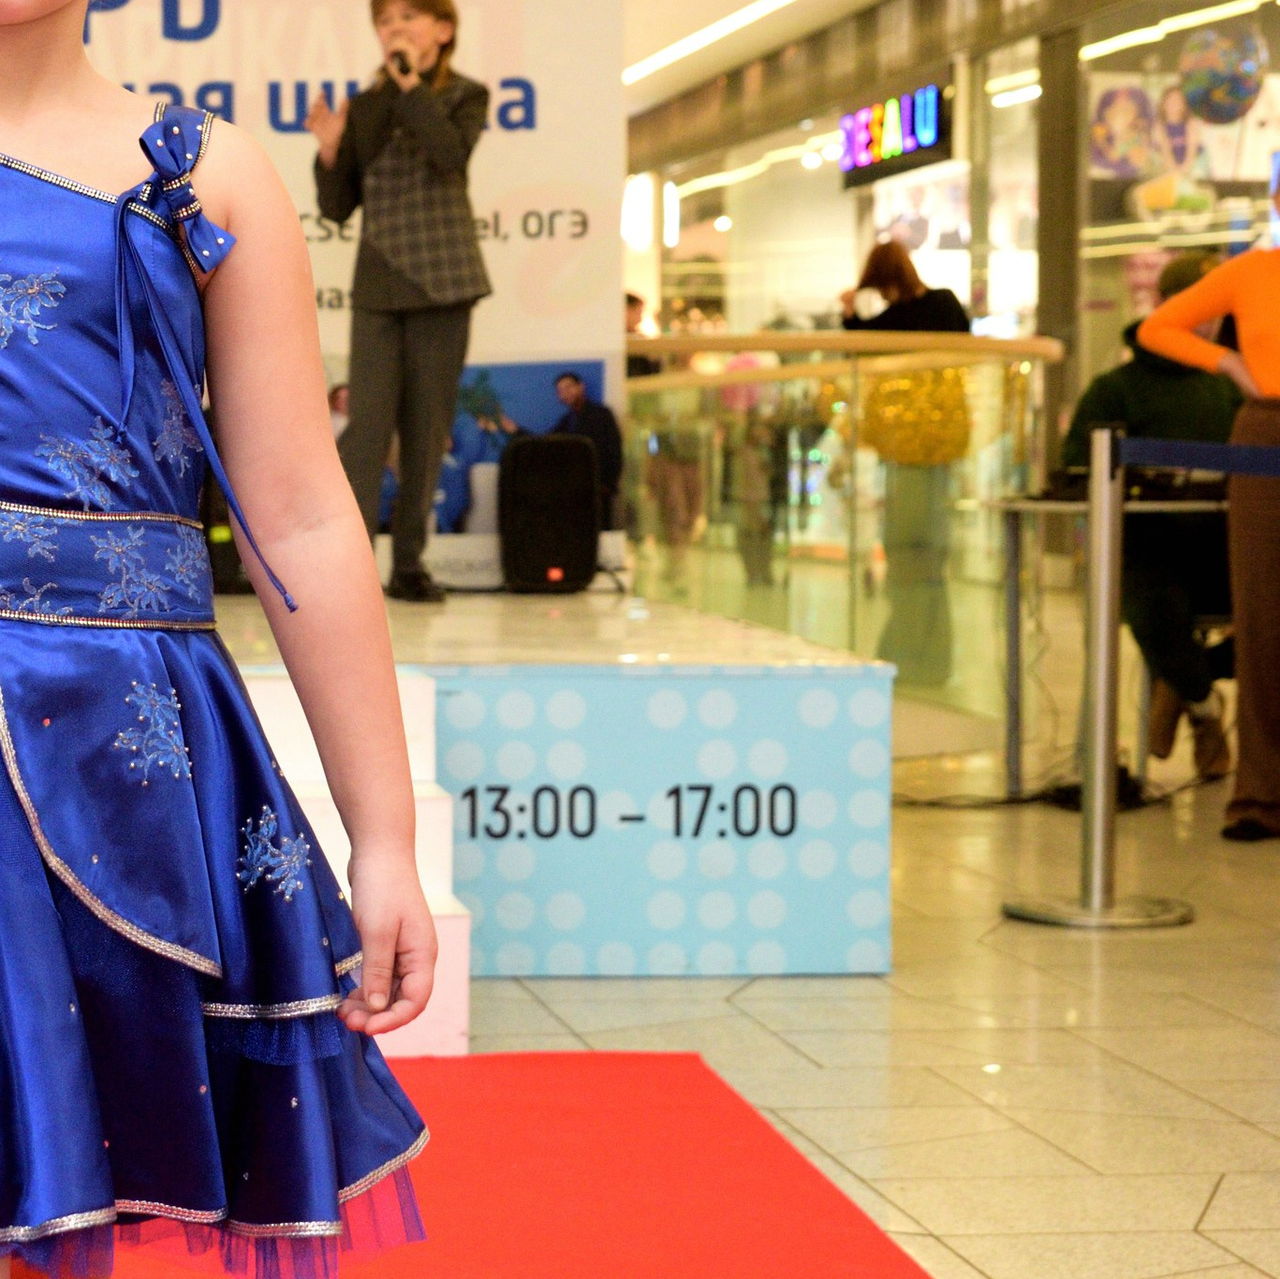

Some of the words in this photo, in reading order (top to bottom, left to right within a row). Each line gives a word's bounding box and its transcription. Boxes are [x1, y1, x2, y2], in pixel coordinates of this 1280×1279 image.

[521, 210, 589, 240] ОГЭ
[460, 785, 597, 839] 13:00
[666, 783, 799, 838] 17:00
